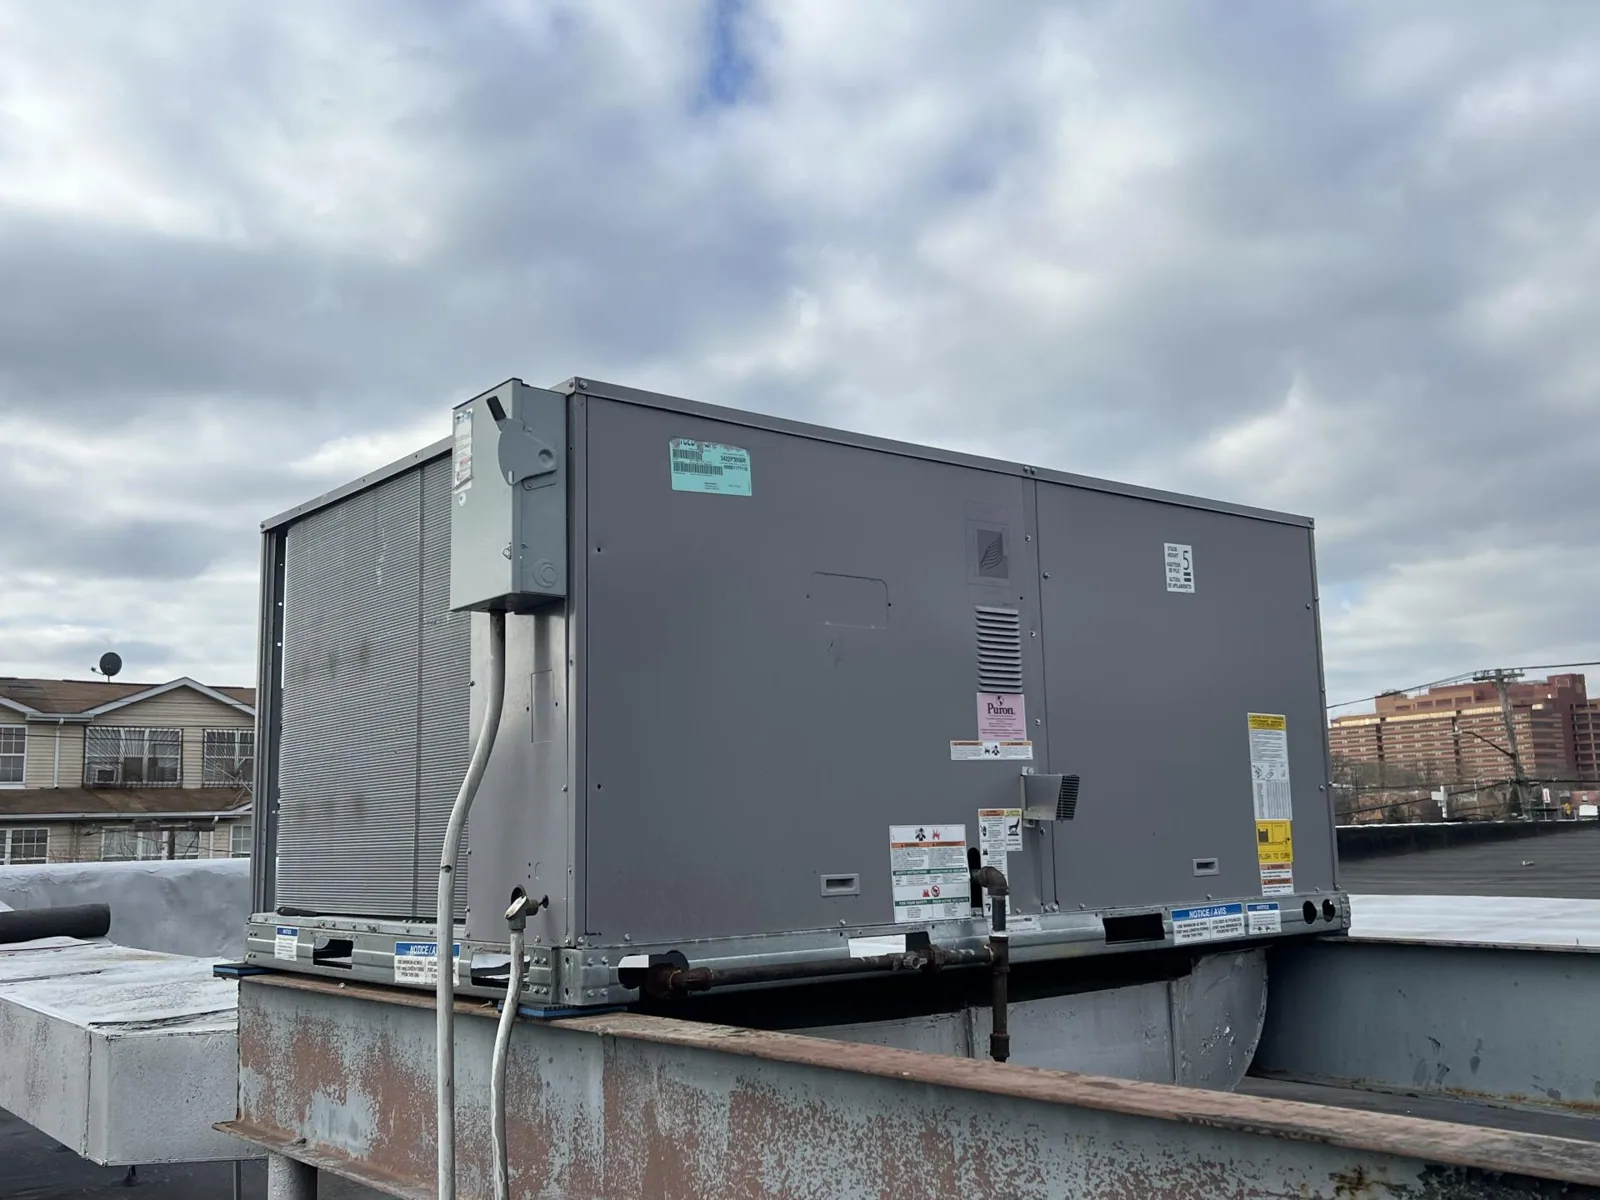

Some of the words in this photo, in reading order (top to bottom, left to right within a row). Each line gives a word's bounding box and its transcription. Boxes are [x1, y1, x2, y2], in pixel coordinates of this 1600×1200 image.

[1183, 550, 1190, 571] 5
[987, 703, 1013, 715] Puron
[1189, 909, 1210, 919] NOTICE
[1213, 907, 1227, 916] AVIS
[410, 944, 429, 955] NOTICE
